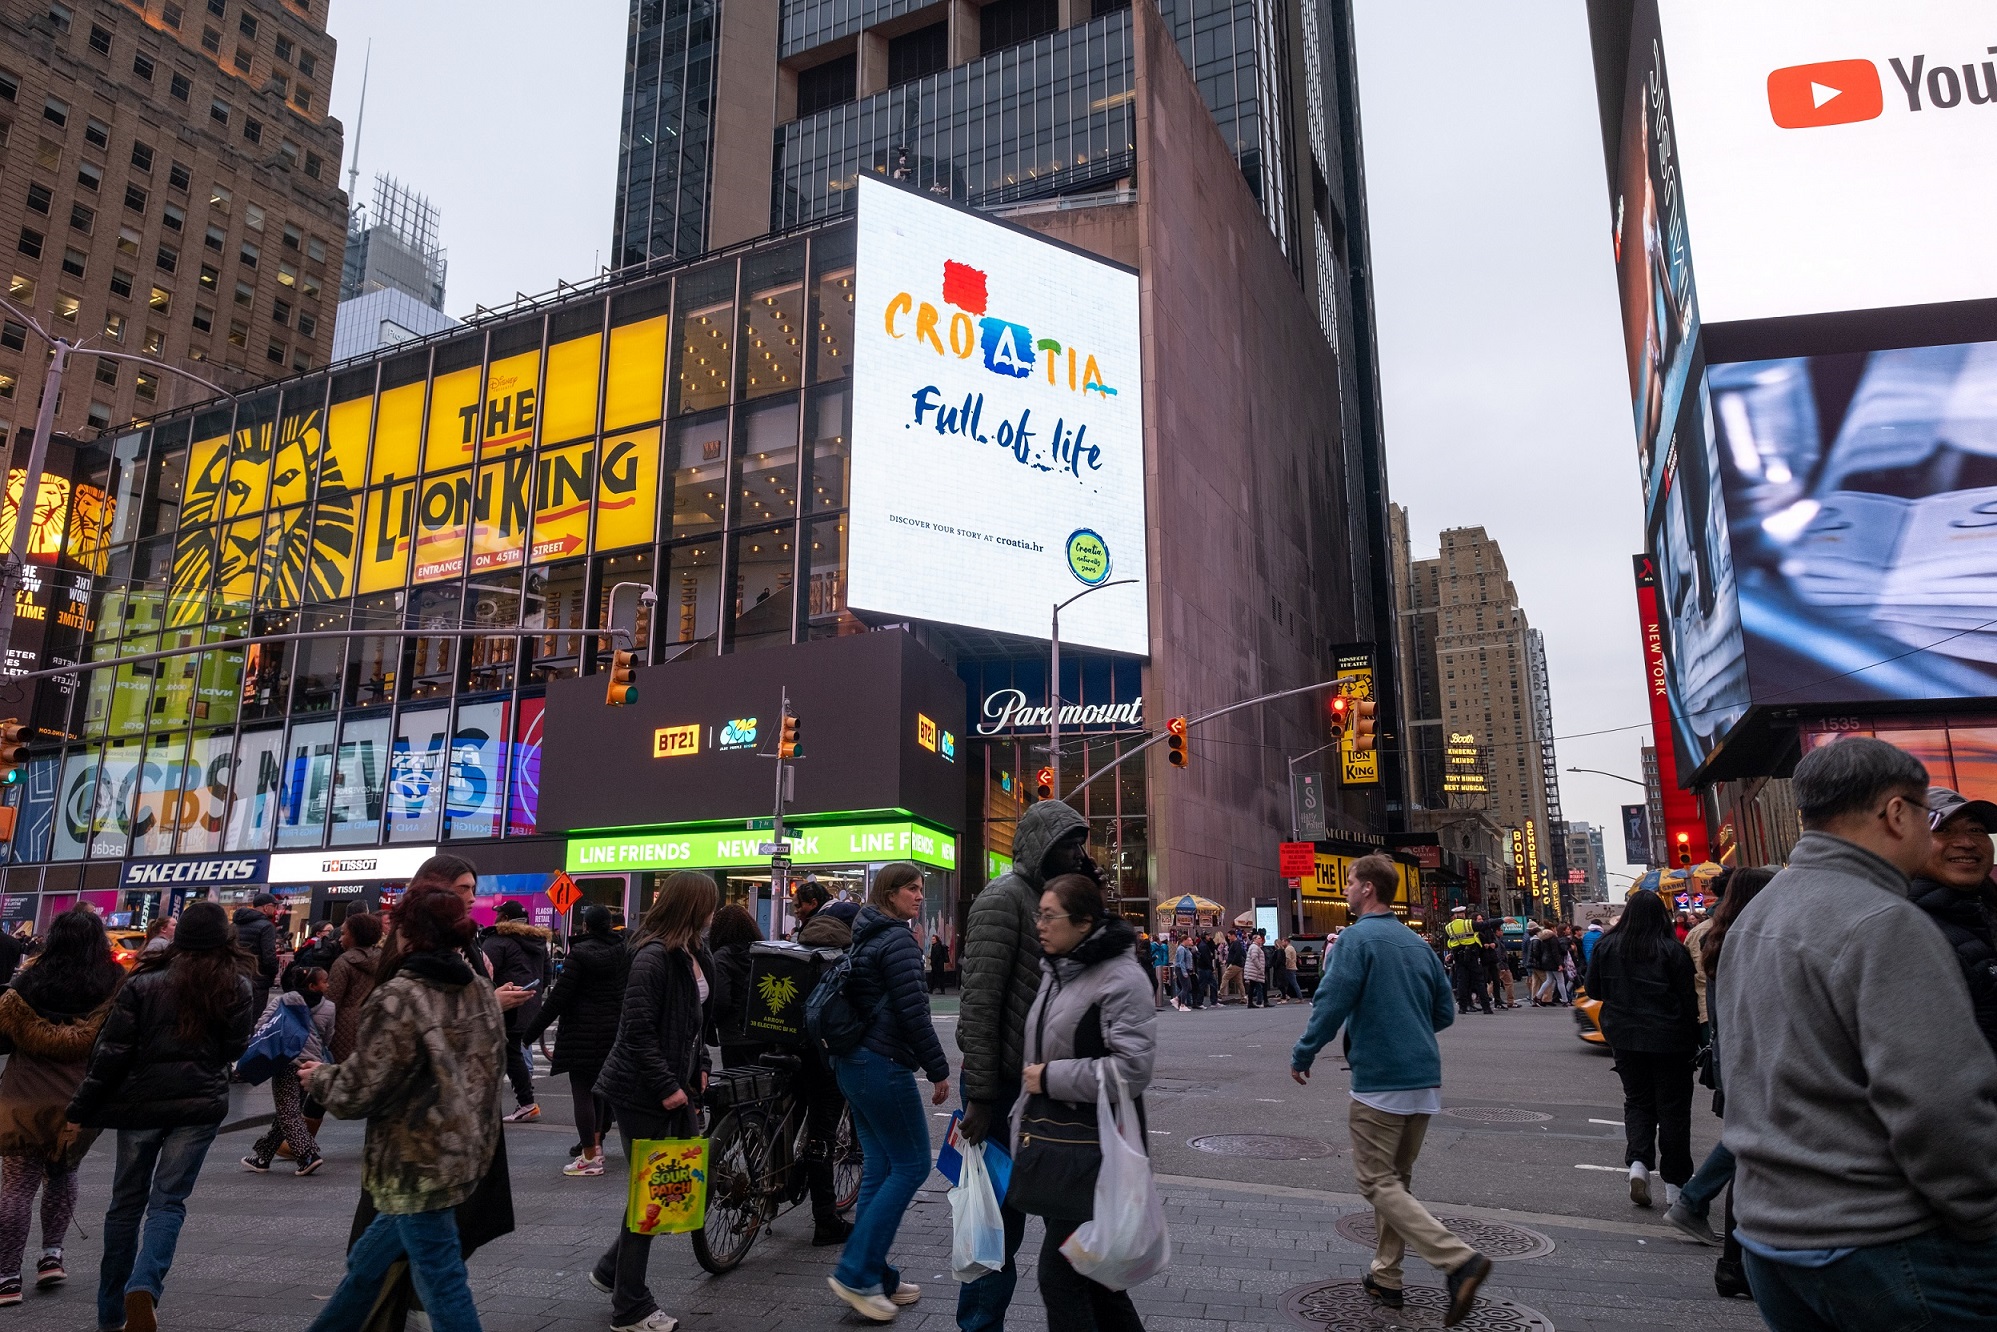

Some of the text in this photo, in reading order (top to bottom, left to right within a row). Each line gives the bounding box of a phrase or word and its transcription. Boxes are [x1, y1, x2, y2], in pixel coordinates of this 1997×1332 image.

[885, 291, 1117, 399] CROATIA
[458, 388, 535, 444] THE
[912, 385, 1102, 478] Full of life
[375, 441, 639, 563] LION KING
[889, 514, 1044, 553] DISCOVER YOUR STORY AT croatia.hr
[1075, 542, 1103, 556] Croatia
[417, 541, 564, 577] ENTRANCE ON 45TH STREET
[1648, 624, 1667, 696] NEW YORK
[976, 688, 1143, 736] Paramount
[1534, 694, 1547, 740] PLAZA
[1819, 716, 1860, 731] 1535
[659, 731, 695, 751] BT21
[1450, 733, 1474, 743] Booth
[1346, 764, 1374, 780] KING
[1348, 750, 1370, 763] LION
[118, 727, 490, 838] CBS NEWS
[579, 846, 615, 863] LINE
[619, 842, 691, 862] FRIENDS
[717, 839, 760, 858] NEW
[851, 832, 894, 853] LINE
[1513, 831, 1526, 886] BOOTH
[1526, 821, 1540, 897] SCHOENFELD
[126, 859, 257, 884] SKECHERS
[1314, 863, 1335, 885] THE
[1541, 869, 1550, 905] JACO
[757, 1021, 782, 1031] ELECTRIC
[763, 1016, 784, 1024] ARROW
[649, 1180, 692, 1201] PATCH
[651, 1169, 690, 1185] SOUR
